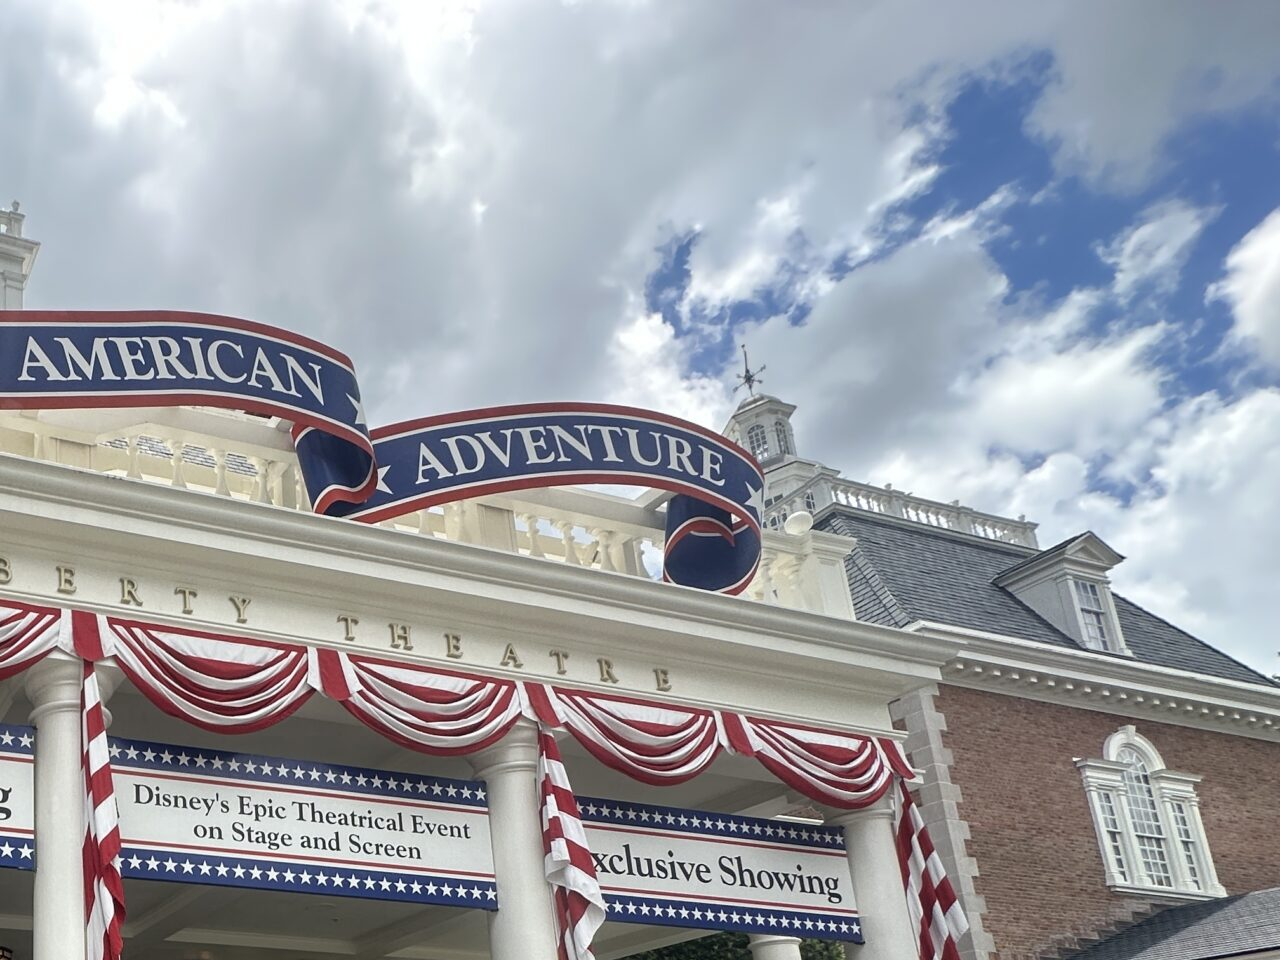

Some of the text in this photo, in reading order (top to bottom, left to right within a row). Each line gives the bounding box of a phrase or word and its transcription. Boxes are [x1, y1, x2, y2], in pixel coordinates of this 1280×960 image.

[17, 335, 325, 406] AMERICAN
[415, 424, 726, 487] ADVENTURE
[337, 615, 673, 693] THEATRE
[133, 783, 471, 839] Disney's Epic Theatrical Event
[193, 822, 422, 860] on Stage and Screen
[591, 843, 843, 904] xclusive Showing
